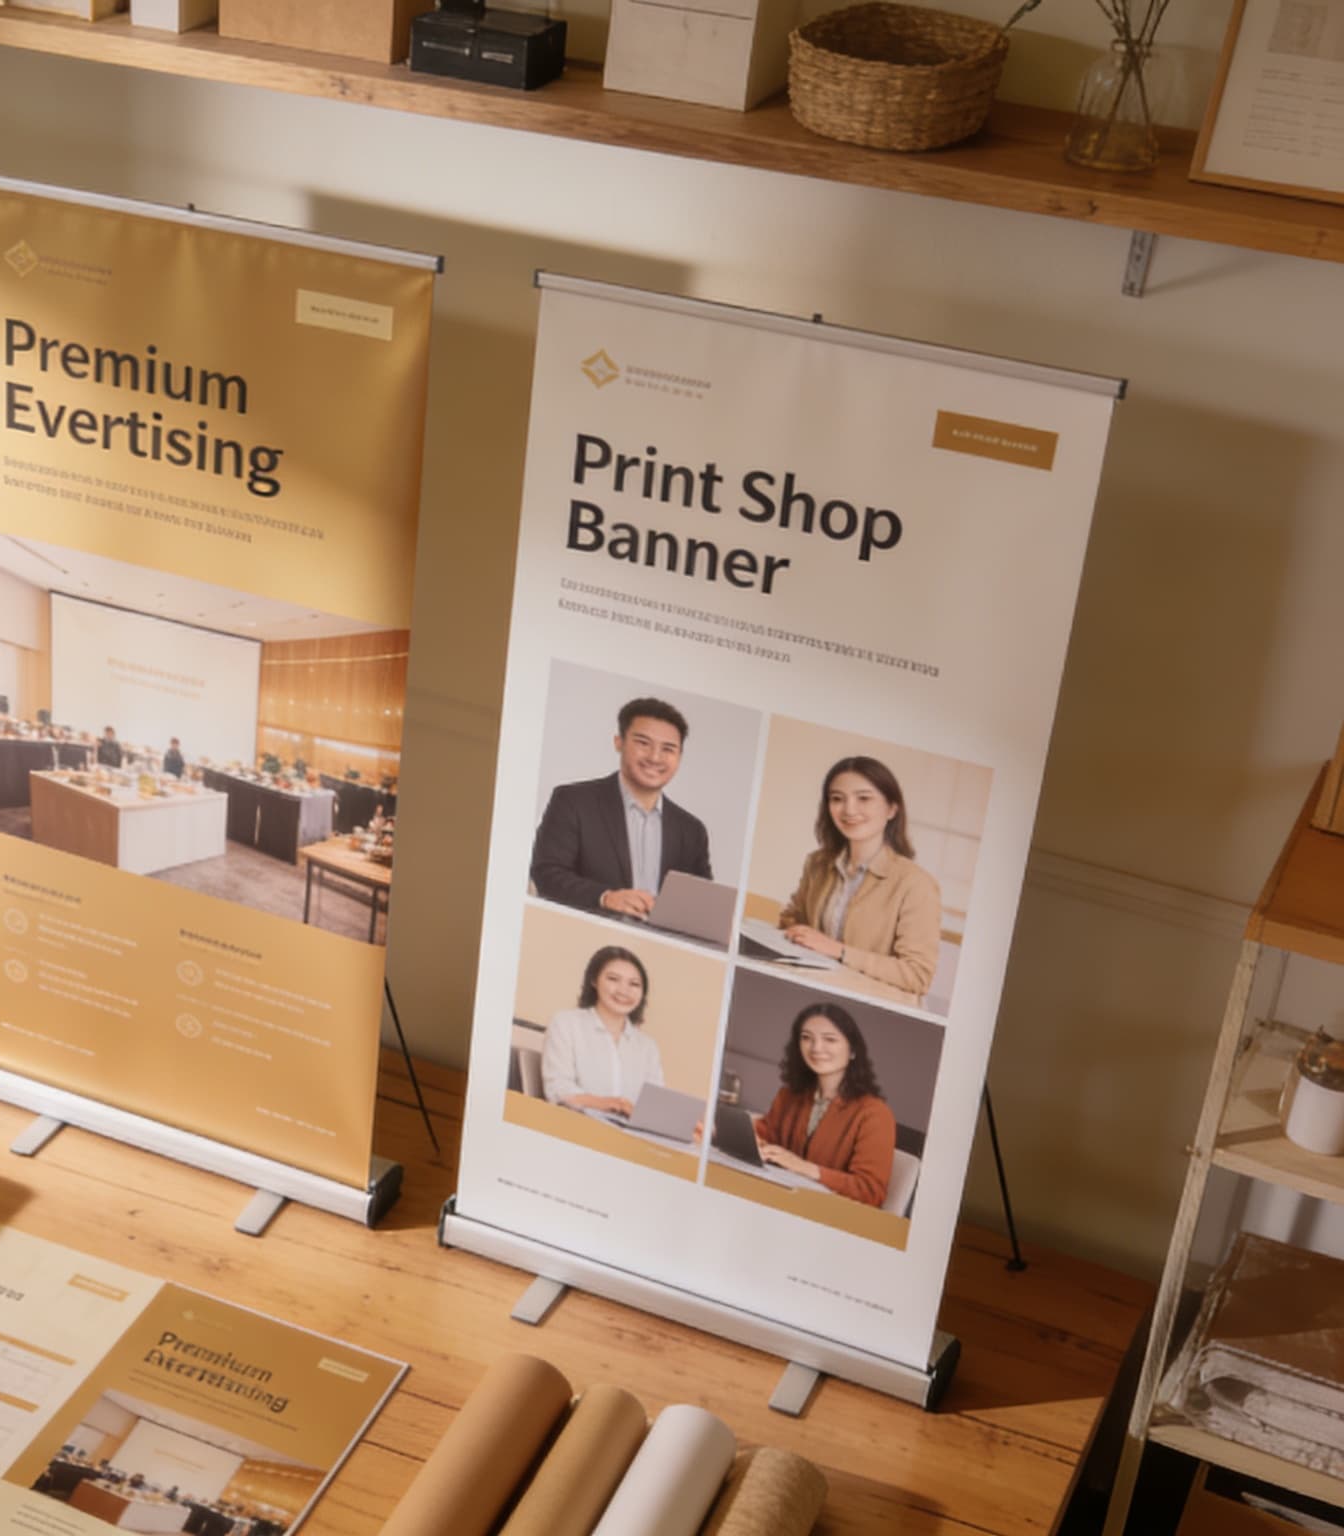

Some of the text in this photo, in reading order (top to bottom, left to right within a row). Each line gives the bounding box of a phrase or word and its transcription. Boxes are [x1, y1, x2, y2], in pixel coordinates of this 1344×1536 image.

[5, 318, 248, 415] Premium
[5, 380, 285, 498] Evertising
[566, 498, 791, 596] Banner
[572, 433, 903, 562] Print Shop
